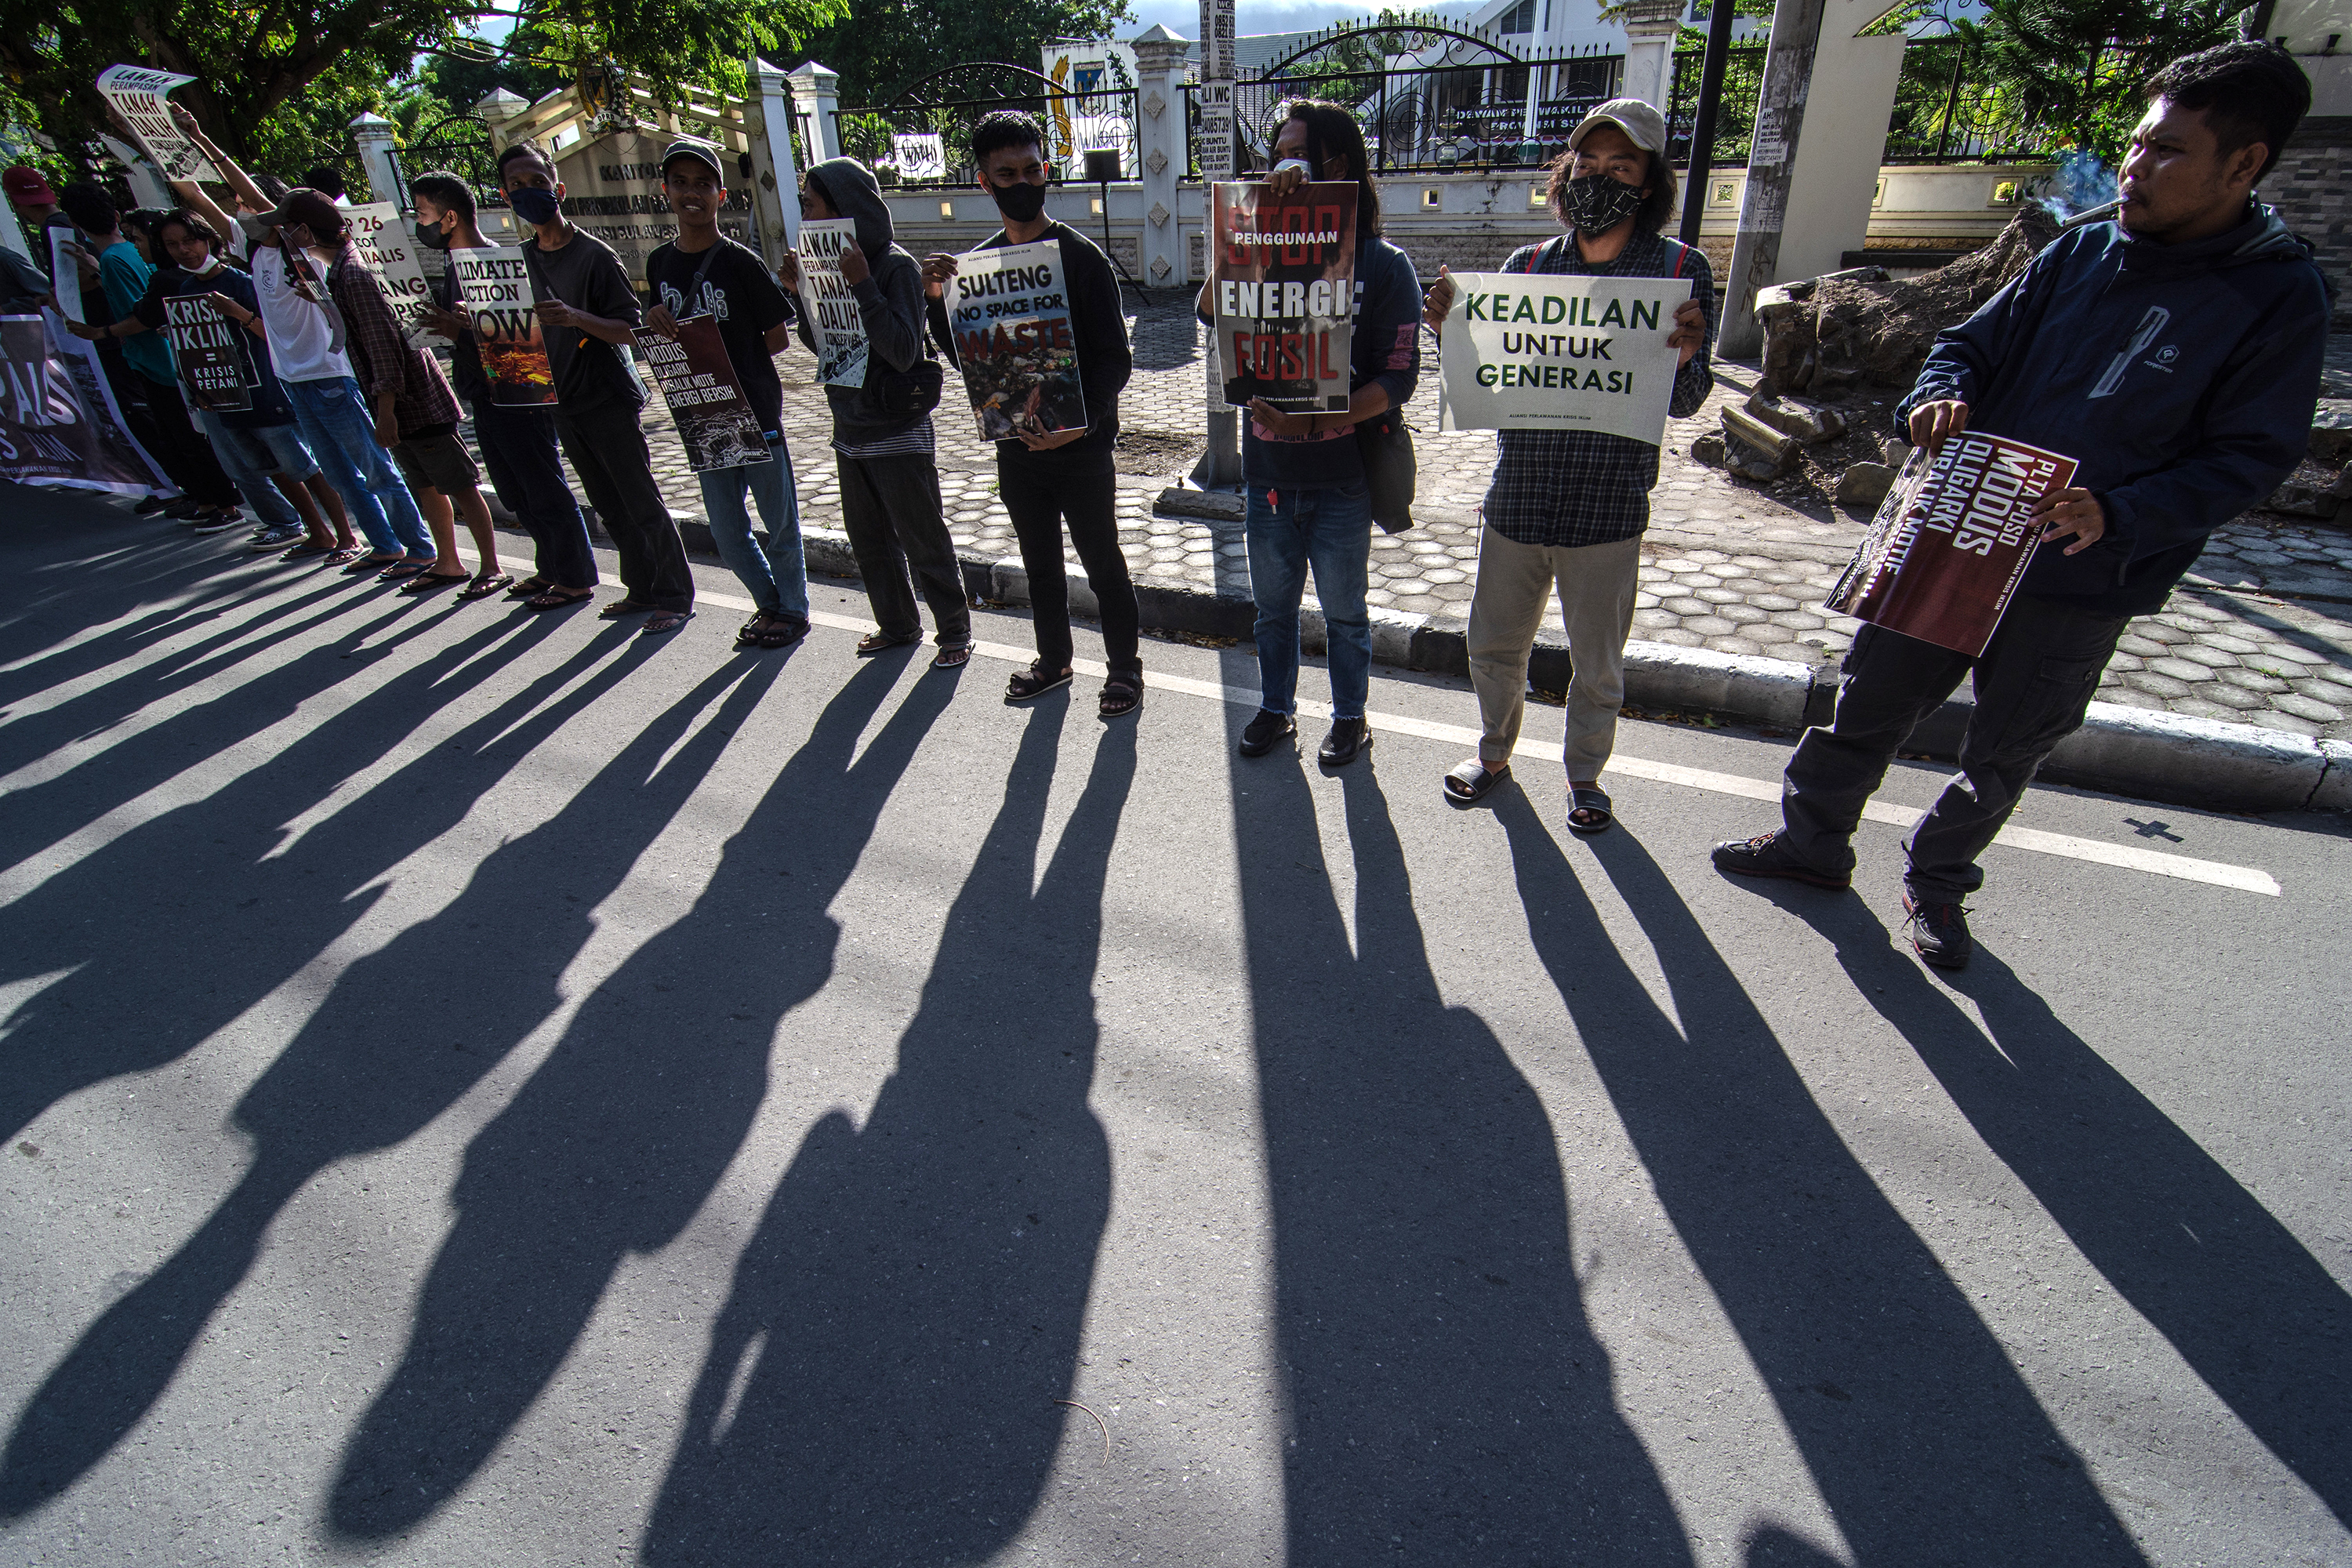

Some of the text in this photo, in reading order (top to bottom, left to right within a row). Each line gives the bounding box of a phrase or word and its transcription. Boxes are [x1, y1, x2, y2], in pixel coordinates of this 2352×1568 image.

[1215, 15, 1228, 27] 0852
[1214, 27, 1228, 38] 0821
[111, 81, 160, 91] PERAMPASAN
[114, 70, 176, 85] LAWAN
[111, 93, 162, 114] TANAH
[1201, 86, 1229, 103] LI WC
[126, 116, 181, 139] DALIH
[599, 162, 665, 180] KANTOR
[358, 216, 384, 232] 26
[354, 237, 378, 248] COT
[798, 231, 841, 258] LAWAN
[1228, 205, 1341, 267] STOP
[1235, 231, 1338, 245] PENGGUNAAN
[359, 248, 405, 265] RIALIS
[803, 260, 840, 273] PERAMPAS
[456, 260, 528, 281] CLIMATE
[378, 277, 426, 298] ANG
[957, 263, 1052, 300] SULTENG
[463, 284, 520, 303] ACTION
[1221, 279, 1347, 318] ENERGI
[817, 302, 860, 331] DALIH
[956, 294, 1065, 323] NO SPACE FOR
[1466, 292, 1661, 330] KEADILAN
[172, 323, 234, 350] IKLIM
[638, 335, 656, 347] PLTA
[957, 317, 1071, 362] WASTE
[1503, 332, 1613, 360] UNTUK
[644, 342, 688, 365] MODUS
[1234, 332, 1338, 381] FOSIL
[194, 365, 235, 379] KRISIS
[654, 361, 691, 379] OLIGARKI
[2143, 361, 2172, 374] FORESTER
[197, 377, 238, 390] PETANI
[660, 373, 717, 394] DIBALIK MOTIF
[1475, 364, 1633, 394] GENERASI
[0, 359, 86, 426] ALS
[667, 384, 737, 409] ENERGI BERSIH
[1911, 437, 1963, 514] DIBALIK
[1926, 440, 1993, 534] OLIGARKI
[1952, 447, 2035, 556] MODUS
[1998, 459, 2057, 547] PLTA POSO
[1884, 516, 1924, 576] MOTIF
[2012, 535, 2037, 575] PERLAWANAN
[2002, 575, 2016, 593] KRISIS
[1994, 594, 2006, 611] IKLIM
